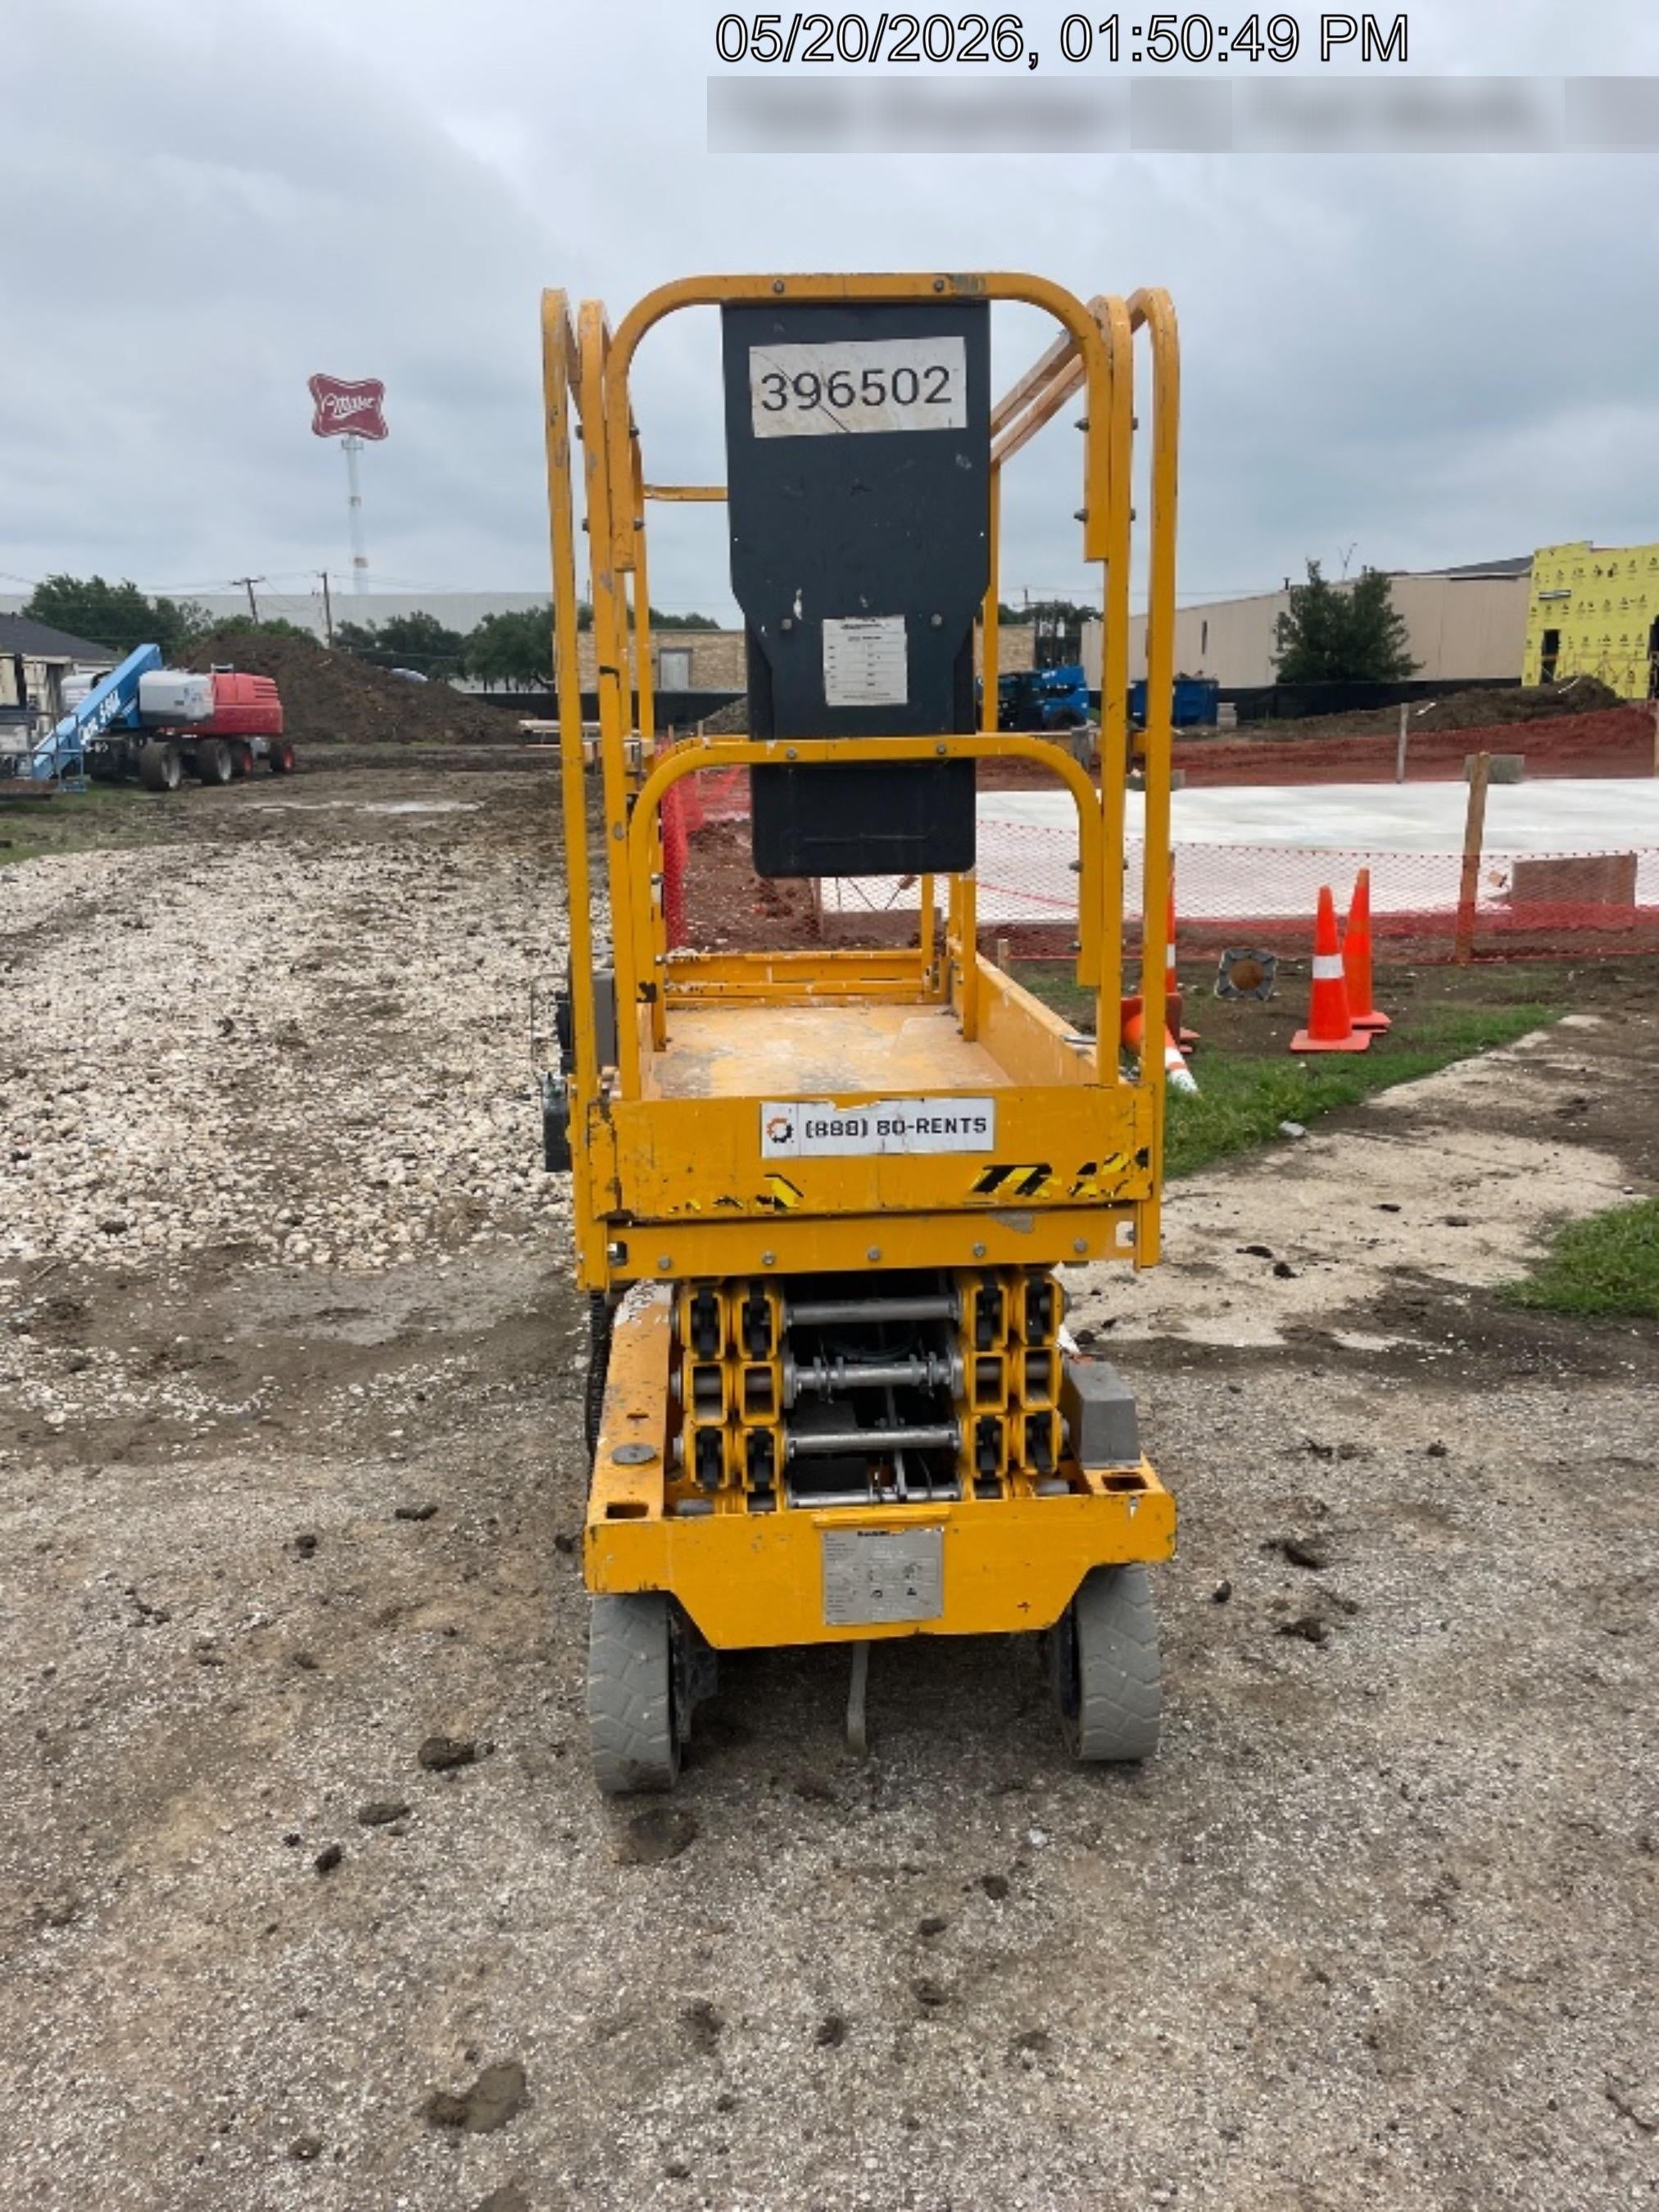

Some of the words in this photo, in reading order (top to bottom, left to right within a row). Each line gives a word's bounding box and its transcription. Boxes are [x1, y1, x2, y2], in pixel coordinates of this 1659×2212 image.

[761, 366, 952, 411] 396502
[321, 393, 375, 417] Miller
[805, 1118, 868, 1139] (888)
